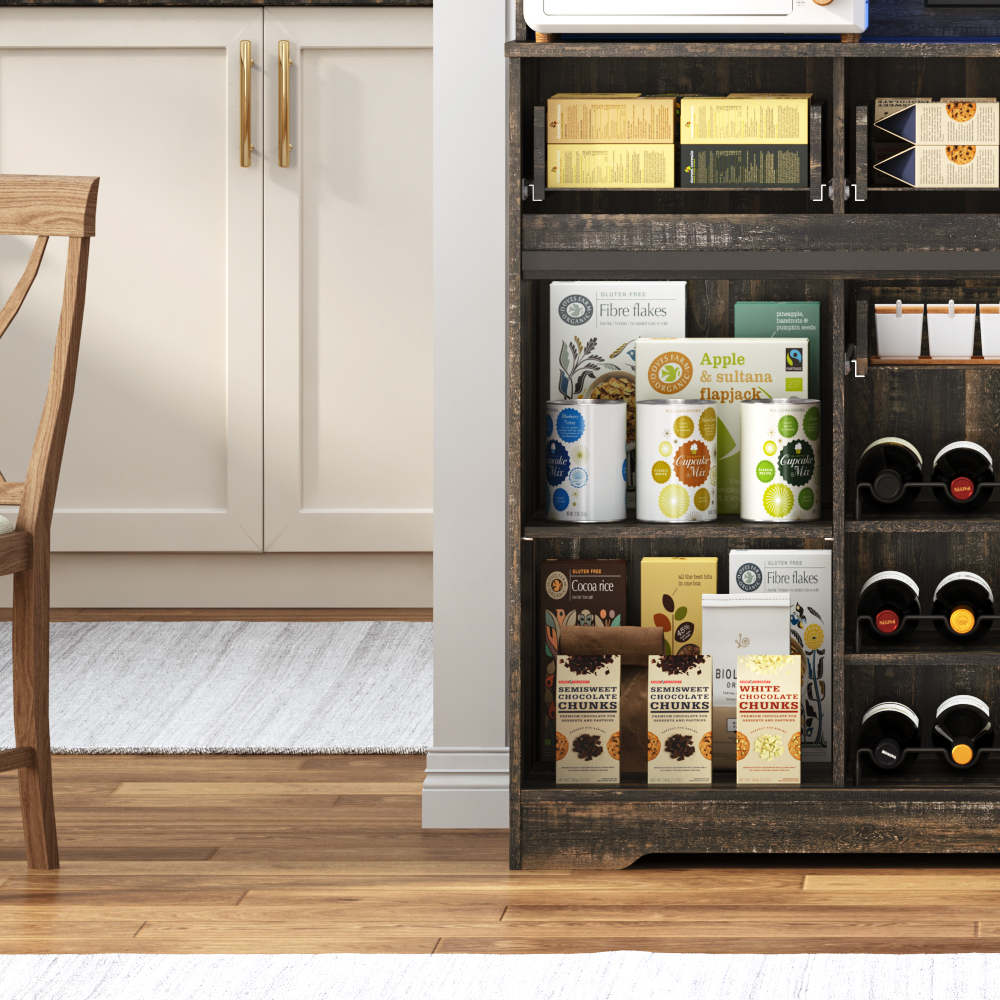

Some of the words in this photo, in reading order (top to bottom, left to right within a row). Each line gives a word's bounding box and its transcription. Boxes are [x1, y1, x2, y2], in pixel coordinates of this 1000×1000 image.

[560, 296, 577, 312] DOVES
[578, 296, 592, 311] FARM
[600, 303, 630, 317] Fibre
[633, 303, 667, 317] flakes
[562, 312, 590, 325] ORGANIC
[650, 354, 669, 380] DOVES
[670, 353, 690, 372] FARM
[700, 353, 745, 368] Apple
[700, 371, 712, 382] &
[716, 370, 773, 383] sultana
[654, 374, 690, 394] ORGANIC
[700, 388, 762, 404] flapjack
[676, 455, 709, 468] Cupcake
[780, 454, 813, 467] Cupcake
[690, 466, 706, 477] Mix
[794, 465, 810, 476] Mix
[737, 564, 750, 579] DOVES
[767, 571, 790, 584] Fibre
[792, 571, 818, 584] flakes
[572, 580, 597, 591] Cocoa
[599, 580, 614, 591] rice
